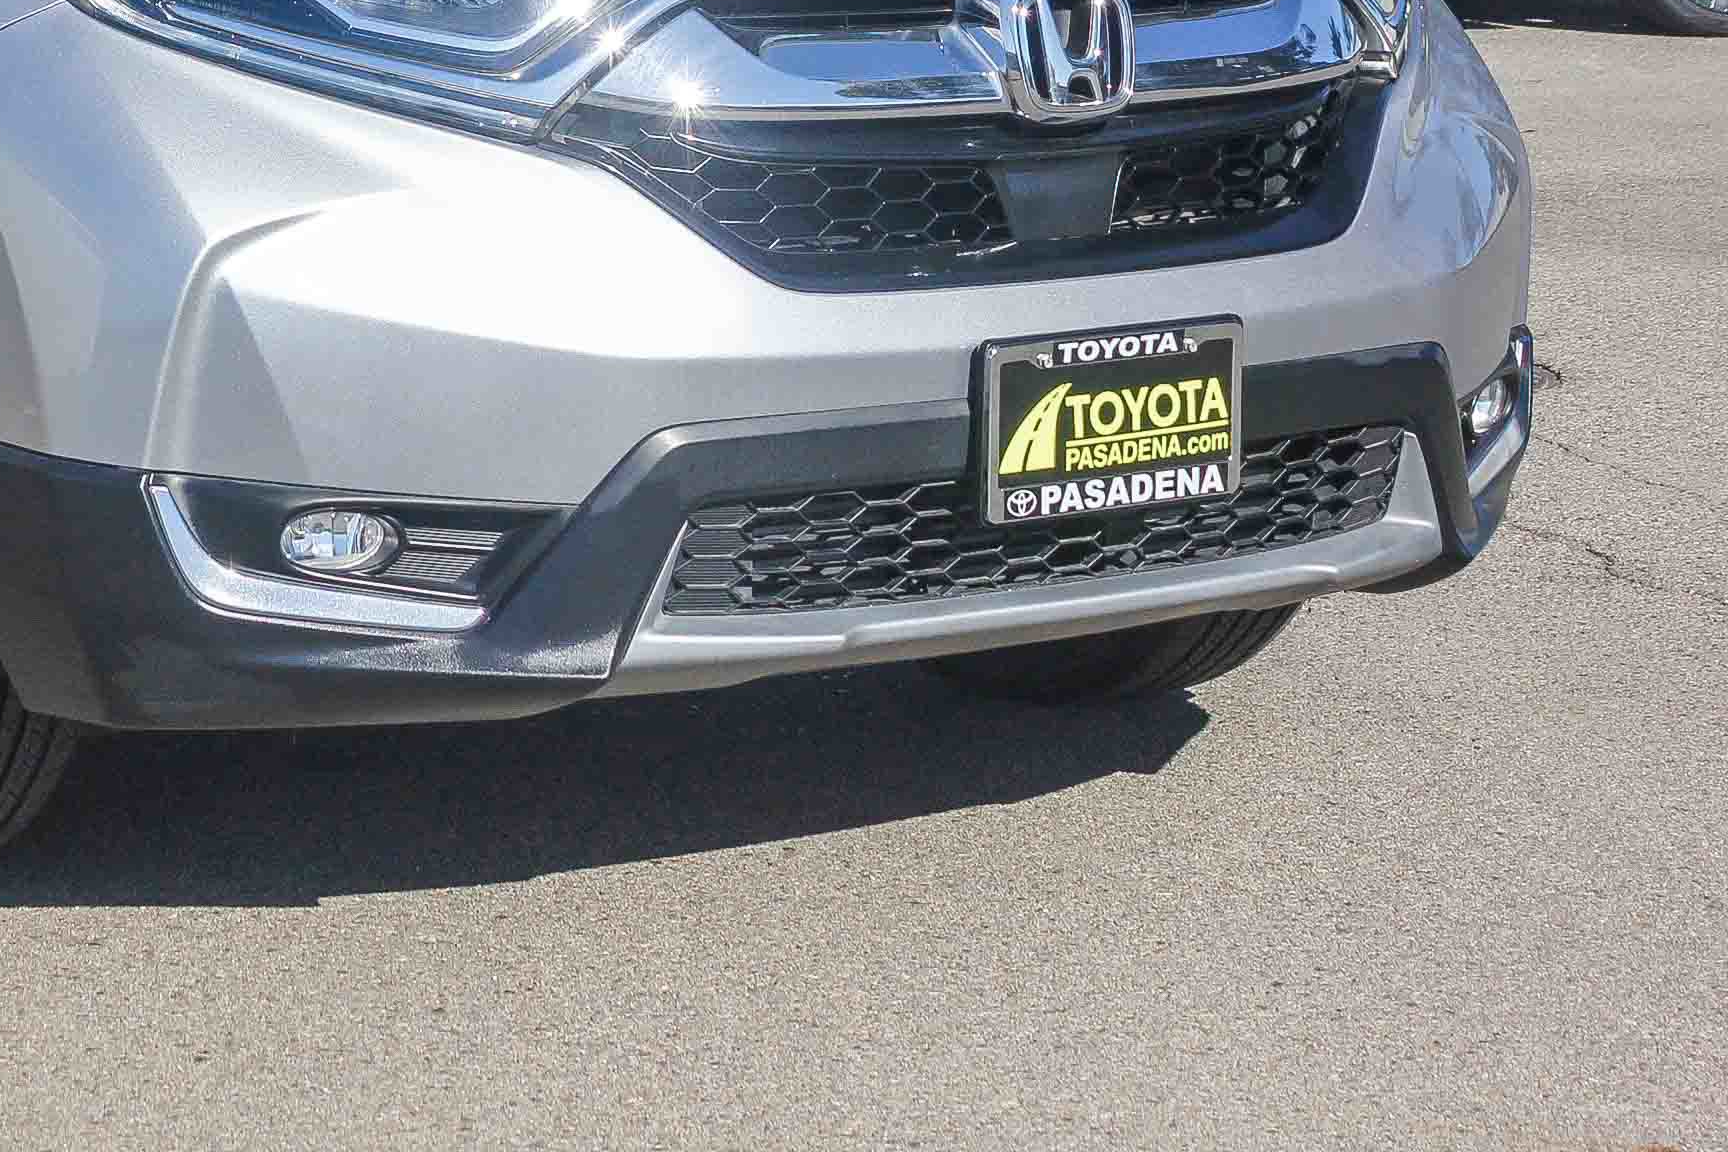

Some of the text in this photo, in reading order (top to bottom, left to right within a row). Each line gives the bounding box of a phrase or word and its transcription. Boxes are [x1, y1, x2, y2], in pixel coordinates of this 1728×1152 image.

[1057, 332, 1178, 364] TOYOTA
[1065, 377, 1229, 439] TOYOTA
[1065, 431, 1229, 473] PASADENA.com
[1040, 463, 1226, 516] PASADENA
